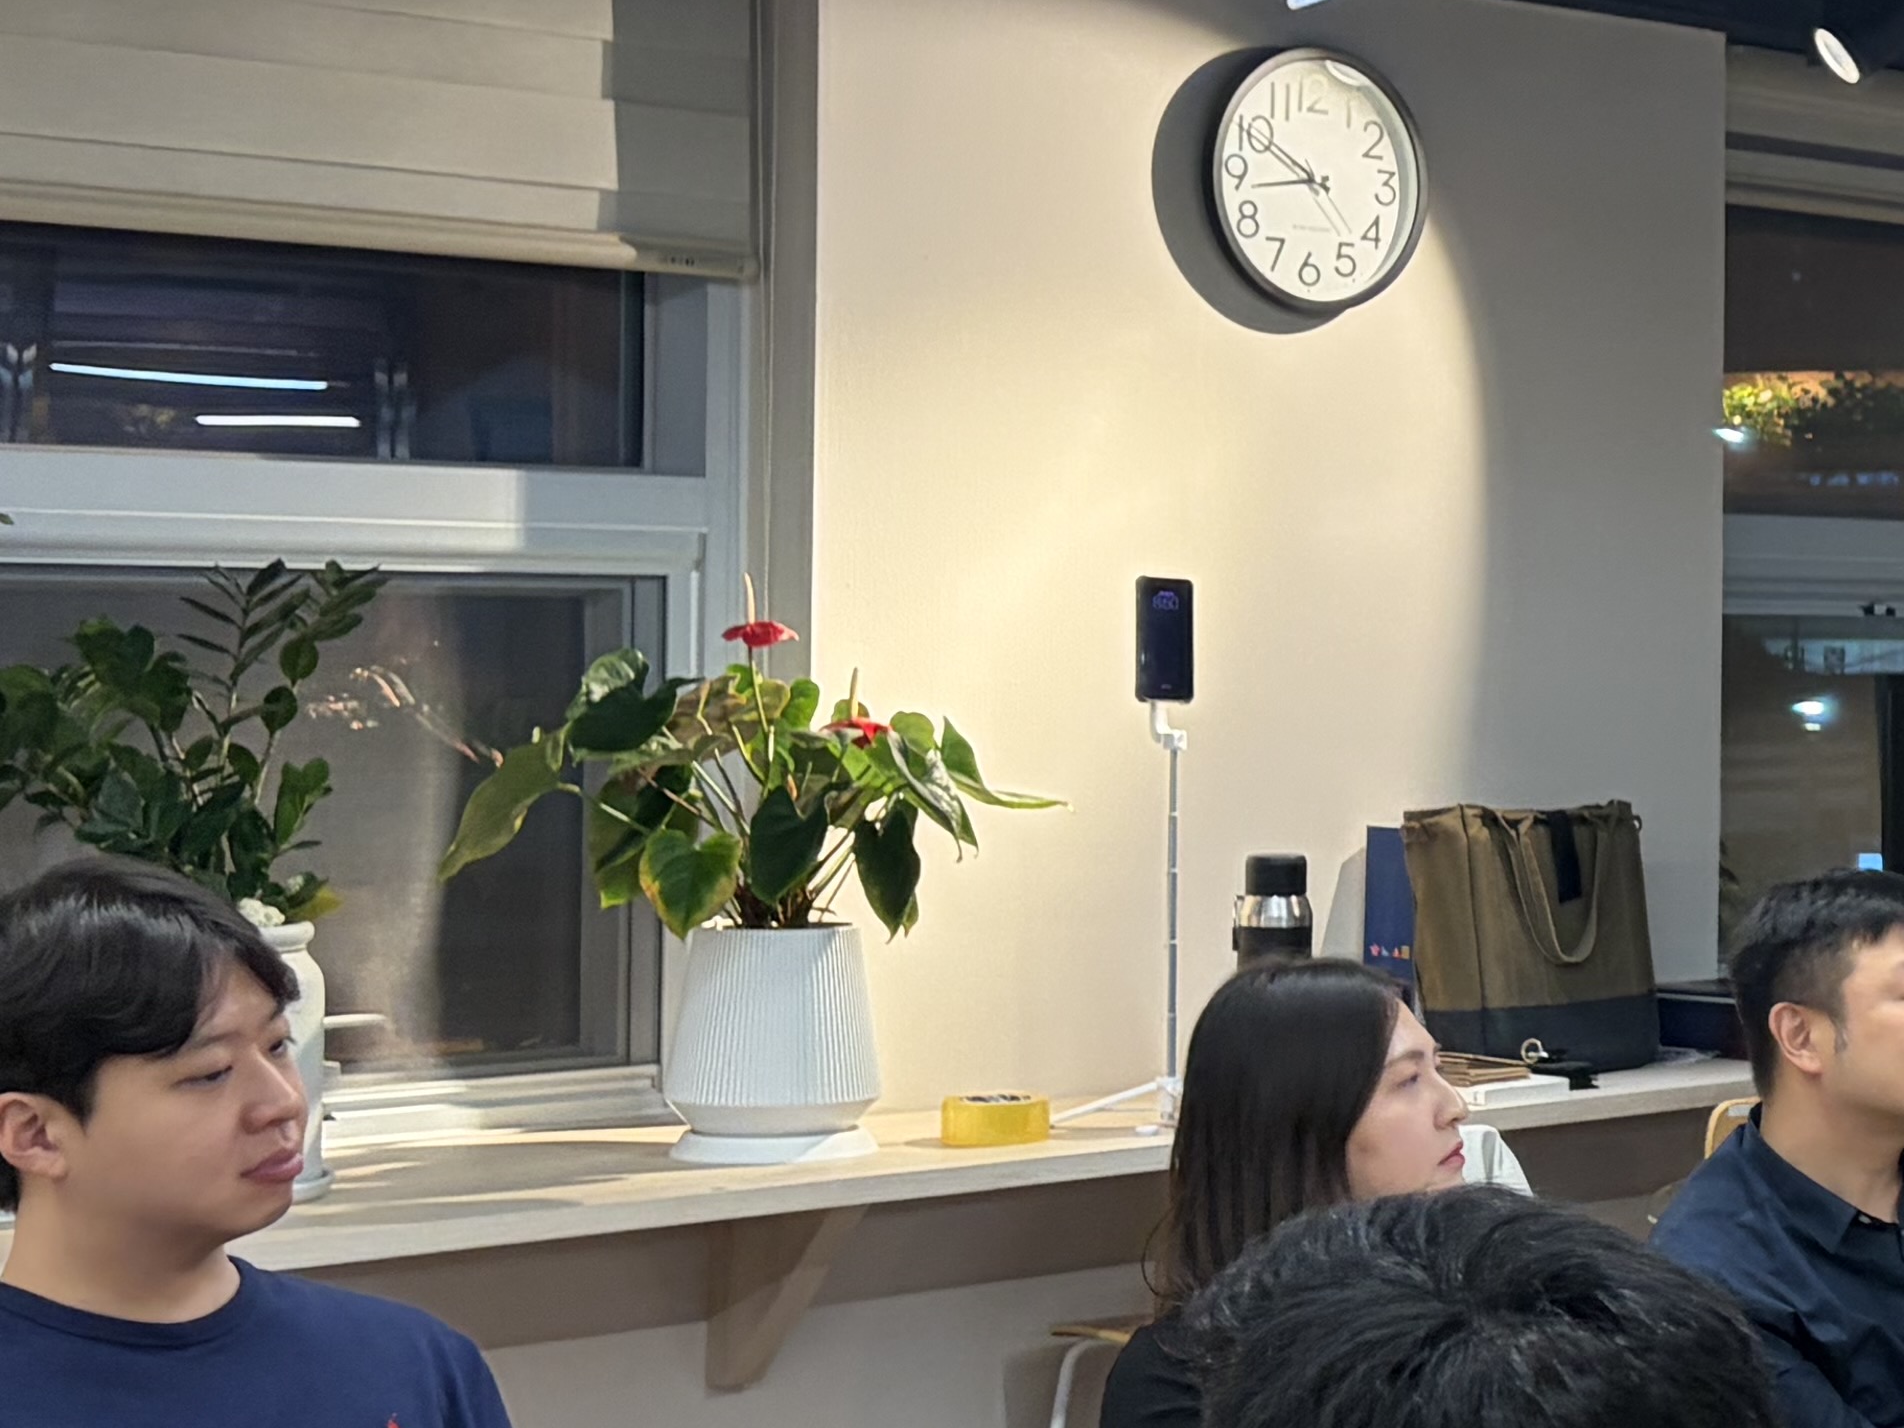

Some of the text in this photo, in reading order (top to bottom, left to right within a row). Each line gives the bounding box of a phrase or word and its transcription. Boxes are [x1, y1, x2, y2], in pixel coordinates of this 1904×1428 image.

[1270, 81, 1290, 122] 11
[1298, 74, 1328, 115] 12
[1237, 113, 1274, 154] 10
[1361, 119, 1384, 161] 2
[1224, 153, 1248, 191] 9
[1374, 168, 1397, 207] 3
[1235, 199, 1260, 238] 8
[1360, 214, 1382, 250] 4
[1265, 235, 1286, 272] 7
[1298, 251, 1321, 287] 6
[1334, 241, 1356, 278] 5
